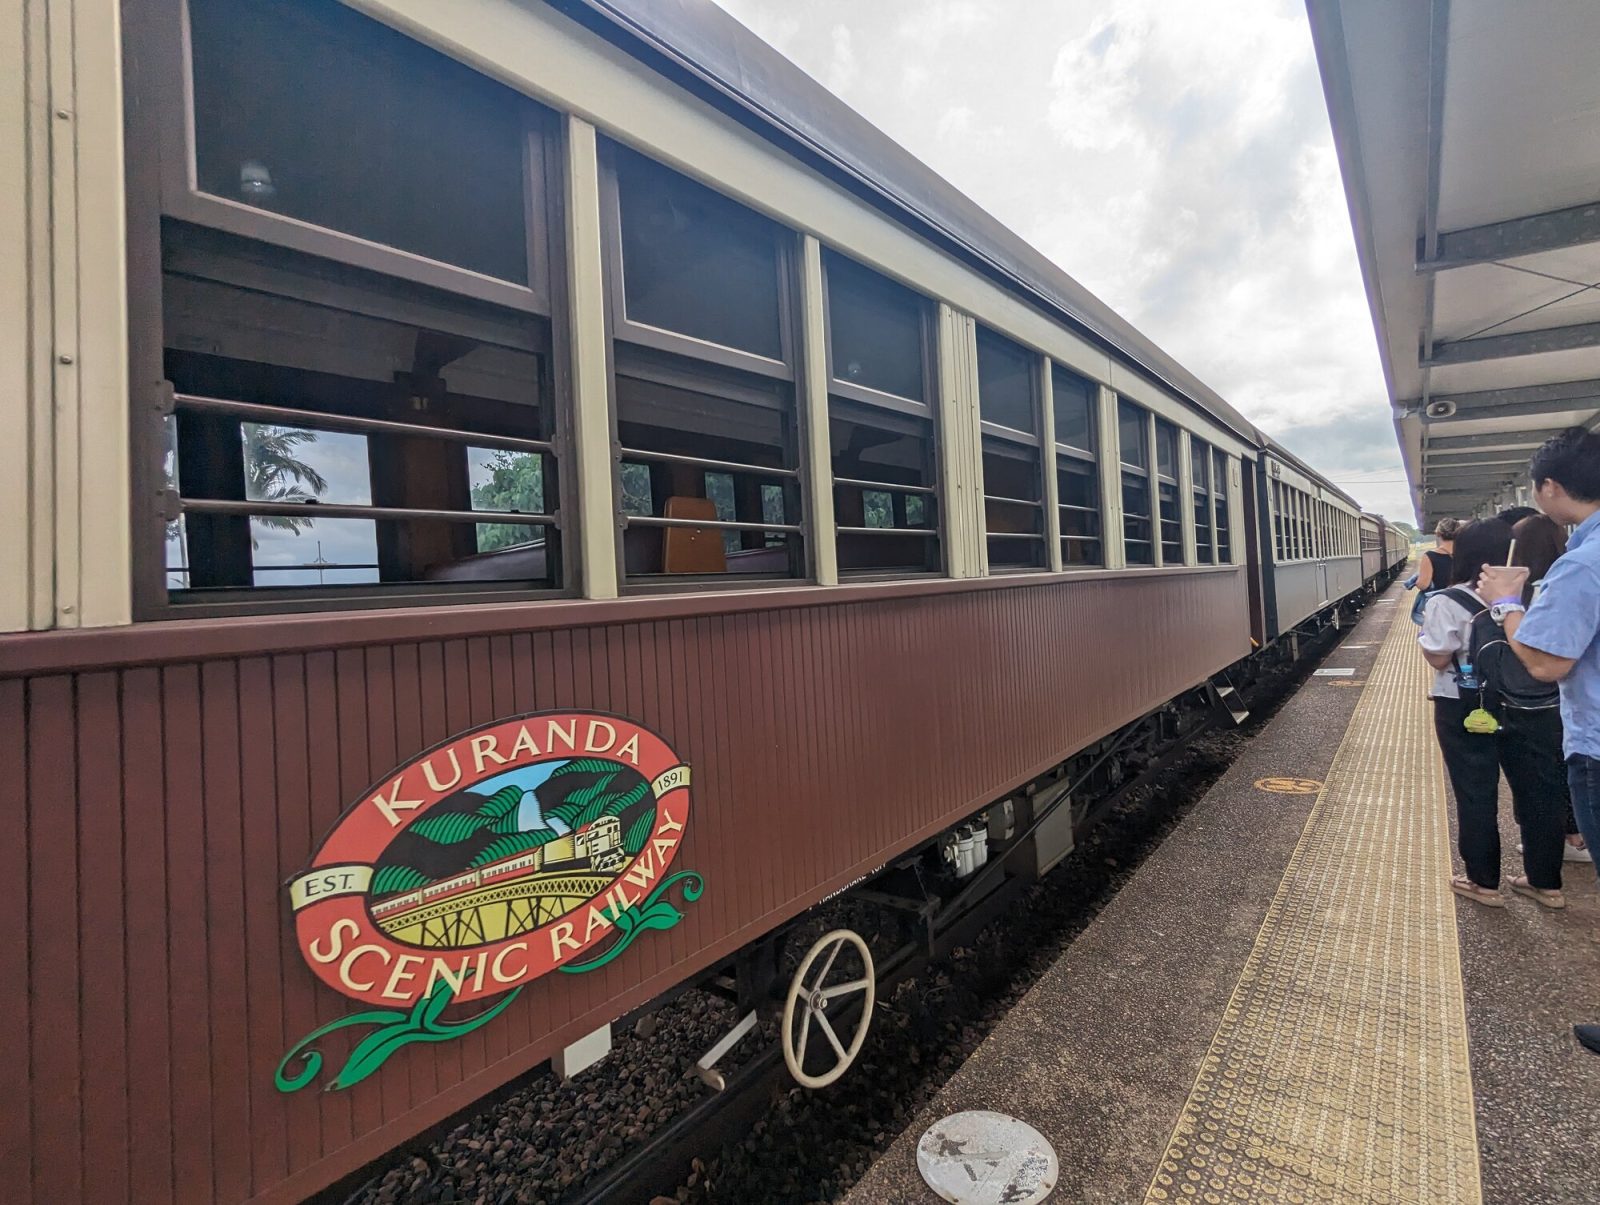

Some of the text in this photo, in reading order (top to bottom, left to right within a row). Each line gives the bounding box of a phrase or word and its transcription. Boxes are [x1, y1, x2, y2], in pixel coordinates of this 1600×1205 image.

[305, 771, 682, 897] EST. 1891
[371, 719, 640, 828] KURANDA
[309, 807, 685, 1000] SCENIC RAILWAY
